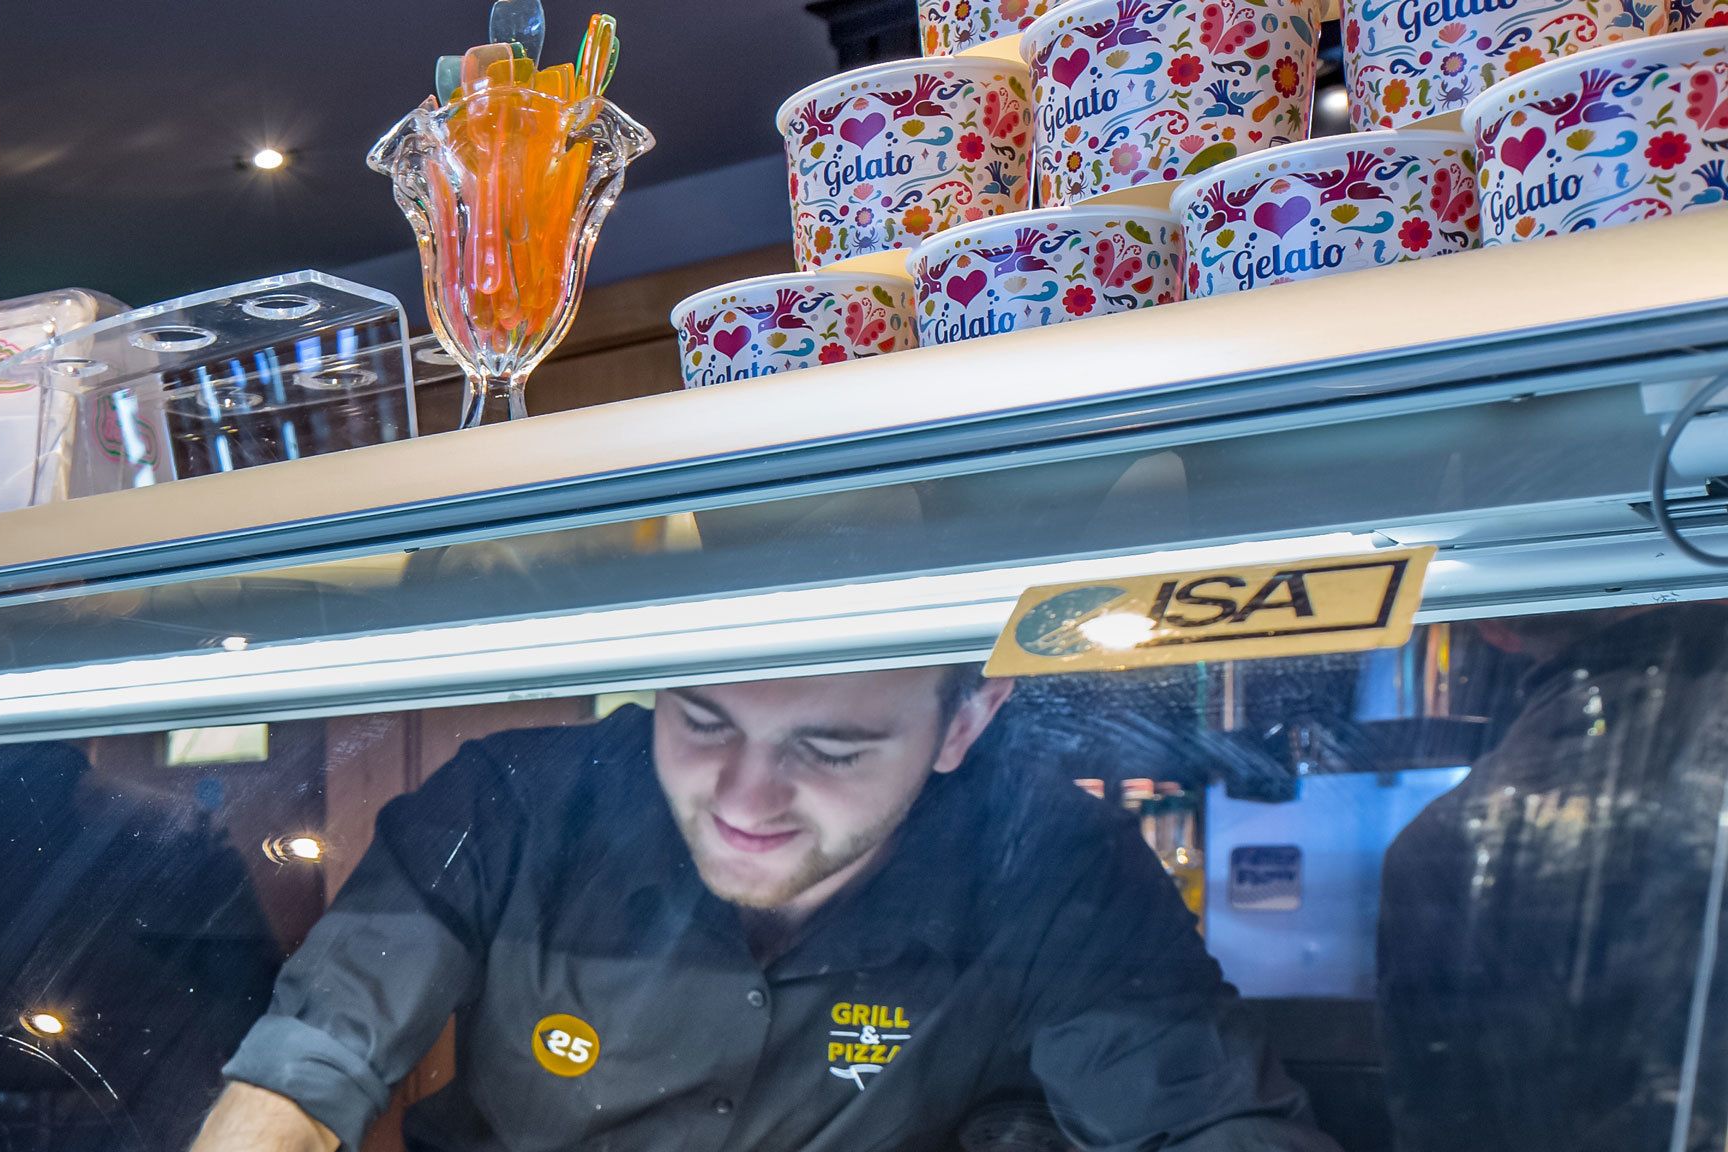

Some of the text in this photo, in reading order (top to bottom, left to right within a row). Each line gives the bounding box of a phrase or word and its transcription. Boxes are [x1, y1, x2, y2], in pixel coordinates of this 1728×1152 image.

[1043, 85, 1120, 143] Gelato
[824, 151, 915, 197] Gelato
[1491, 172, 1584, 236] Gelato
[1233, 240, 1346, 291] Gelato
[935, 309, 1016, 344] Gelato
[1149, 571, 1314, 629] ISA
[831, 1002, 910, 1028] GRILL
[860, 1025, 880, 1045] &
